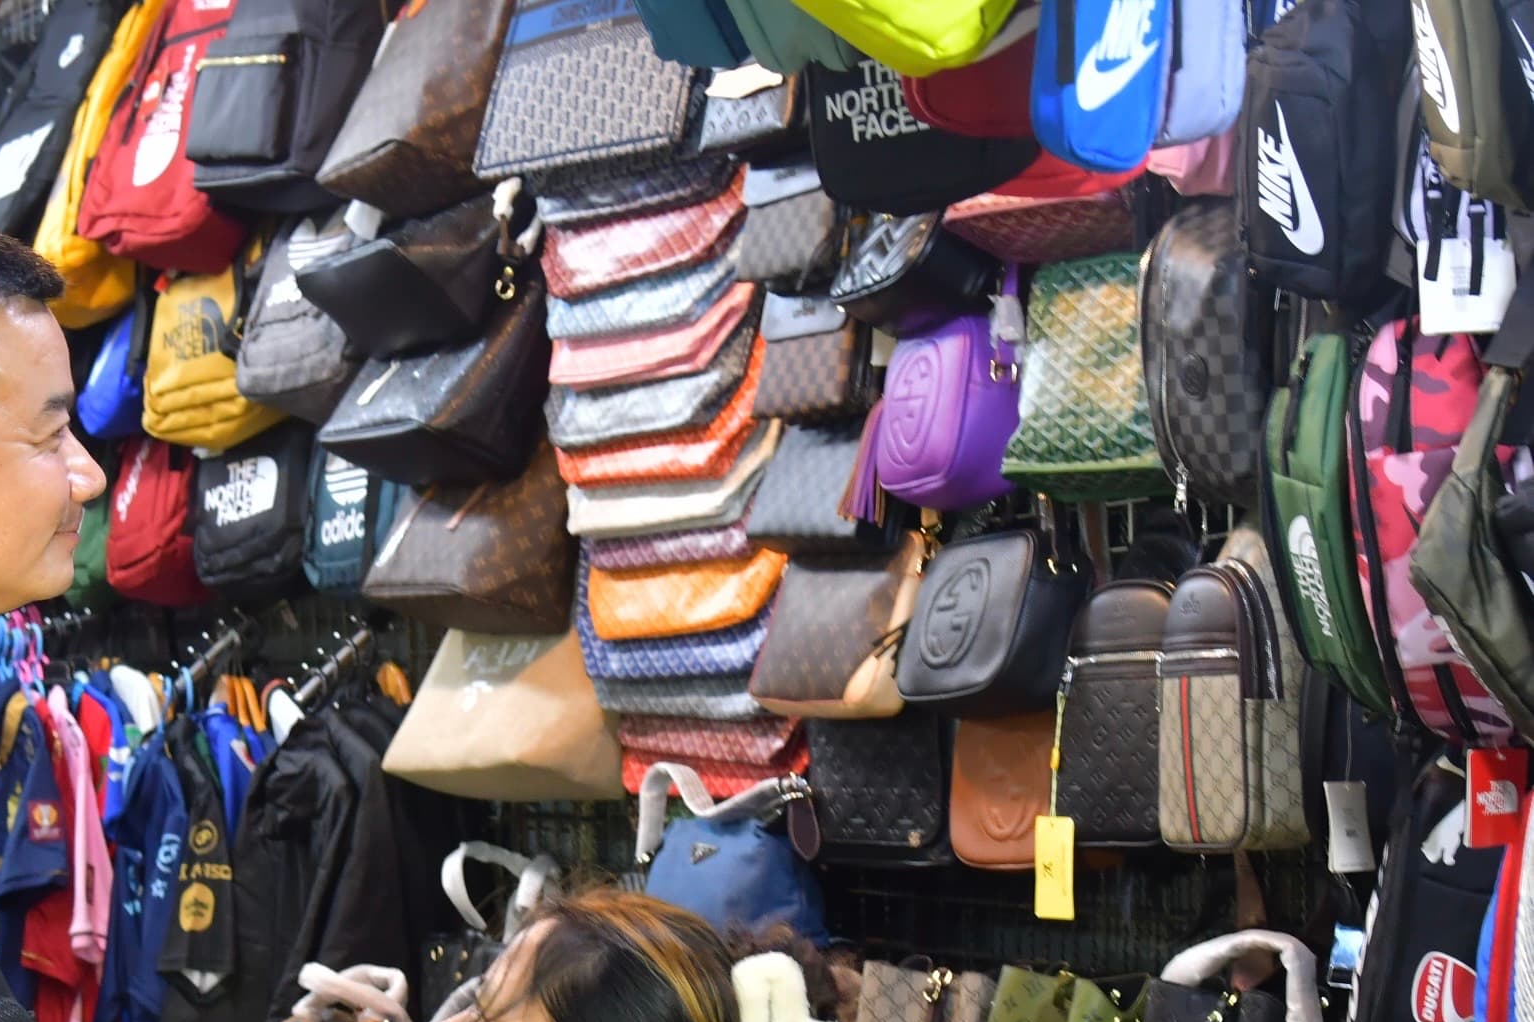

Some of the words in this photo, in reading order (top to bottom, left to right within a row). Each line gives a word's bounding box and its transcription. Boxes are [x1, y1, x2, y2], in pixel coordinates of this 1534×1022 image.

[1411, 1, 1447, 110] NIKE
[851, 106, 918, 143] FACE
[1257, 126, 1295, 232] NIKE
[226, 457, 258, 483] THE
[204, 479, 255, 512] NORTH
